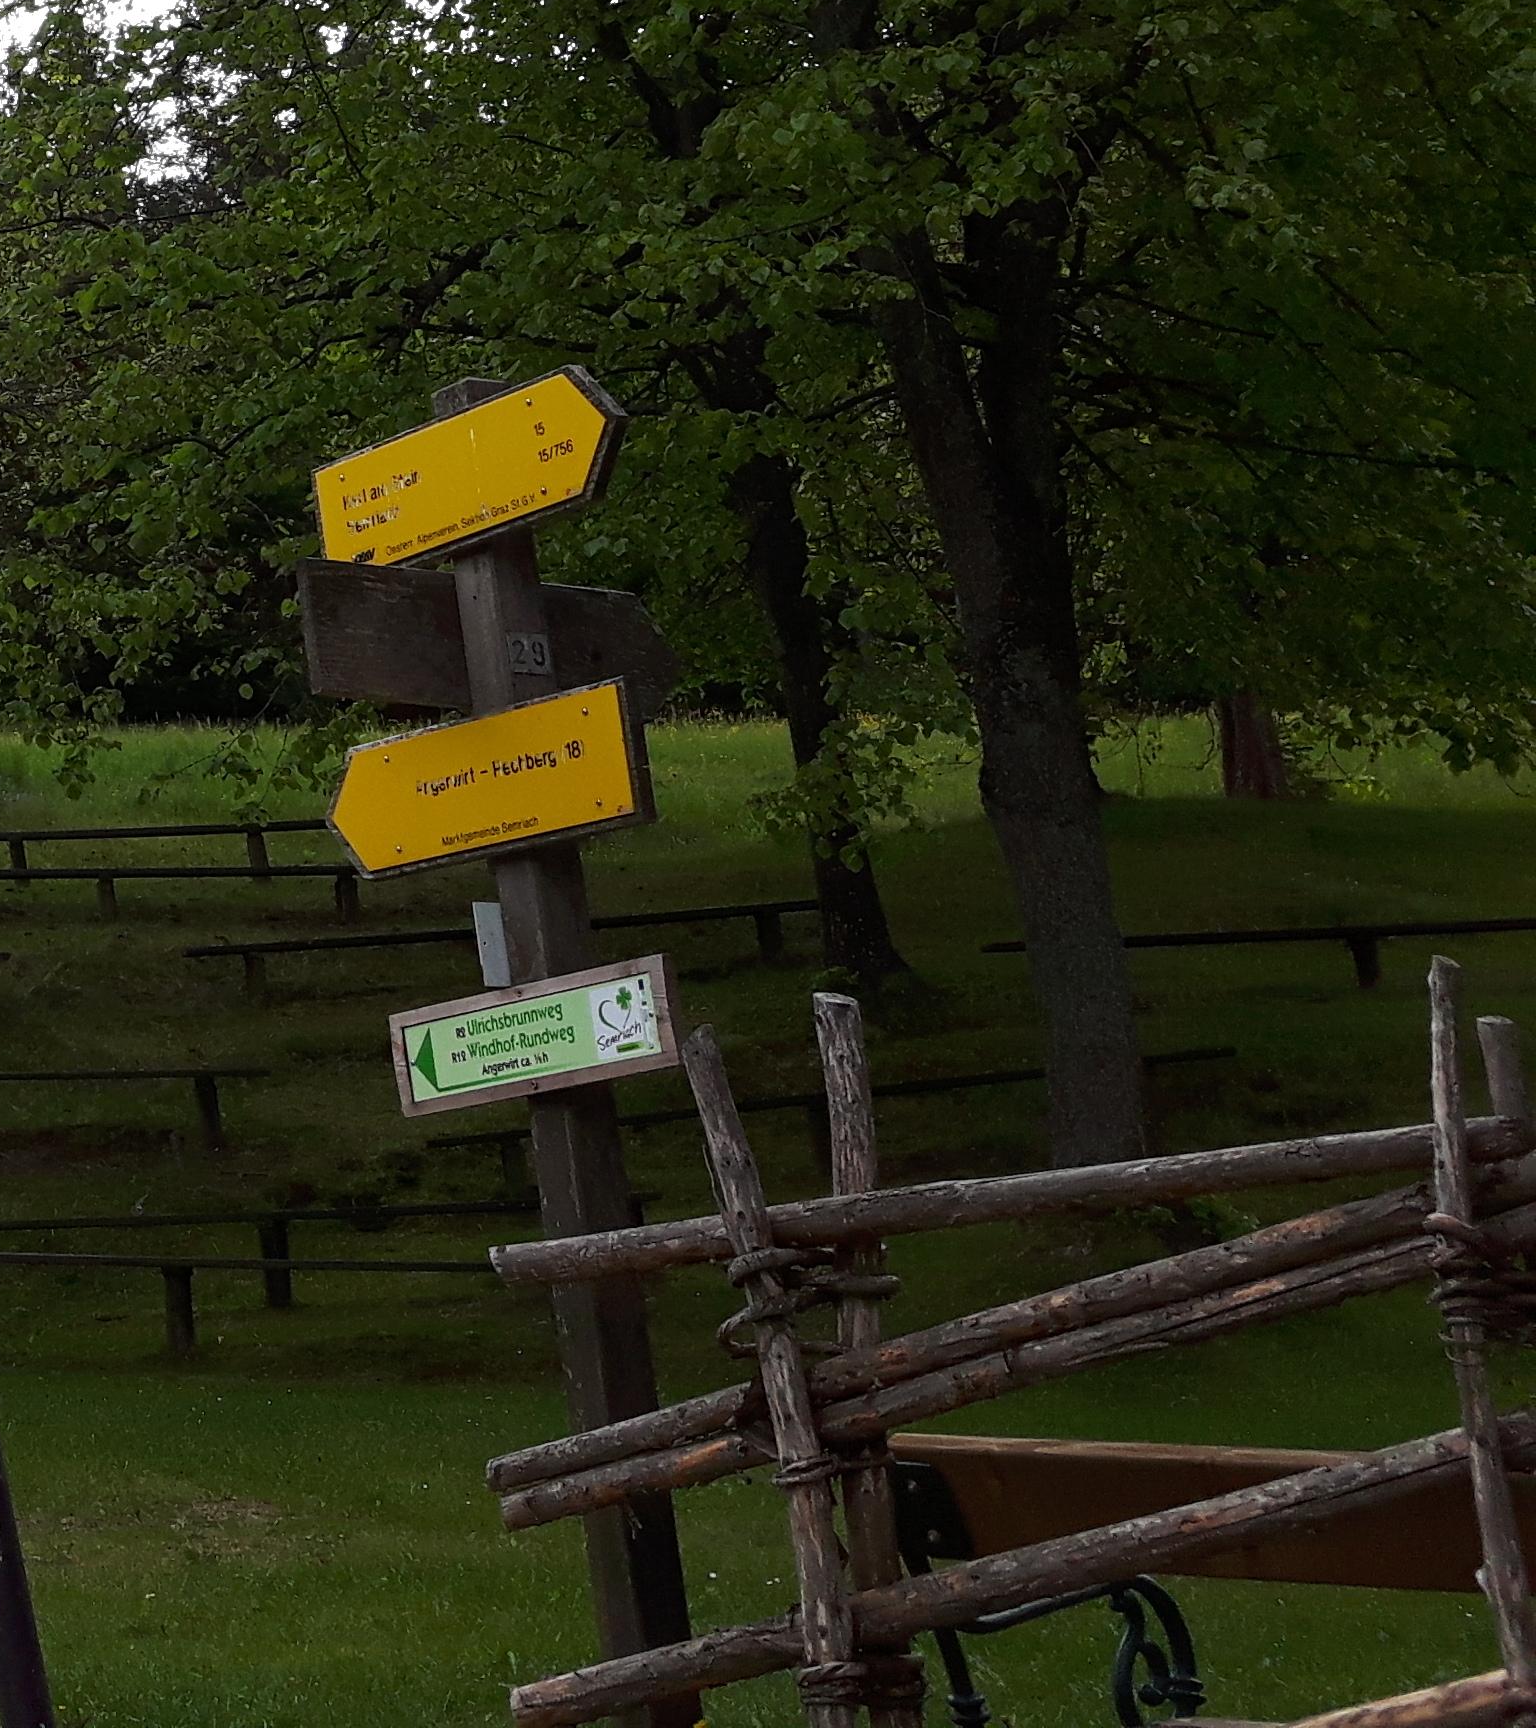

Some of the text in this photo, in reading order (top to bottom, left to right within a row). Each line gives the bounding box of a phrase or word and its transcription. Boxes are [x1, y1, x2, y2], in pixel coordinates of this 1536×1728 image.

[534, 420, 545, 437] 15
[537, 438, 574, 463] 15/756
[466, 1002, 564, 1037] Ulrichsbrunnweg
[466, 1024, 576, 1059] Windhof-Rundweg
[481, 1057, 520, 1076] Angerwirt
